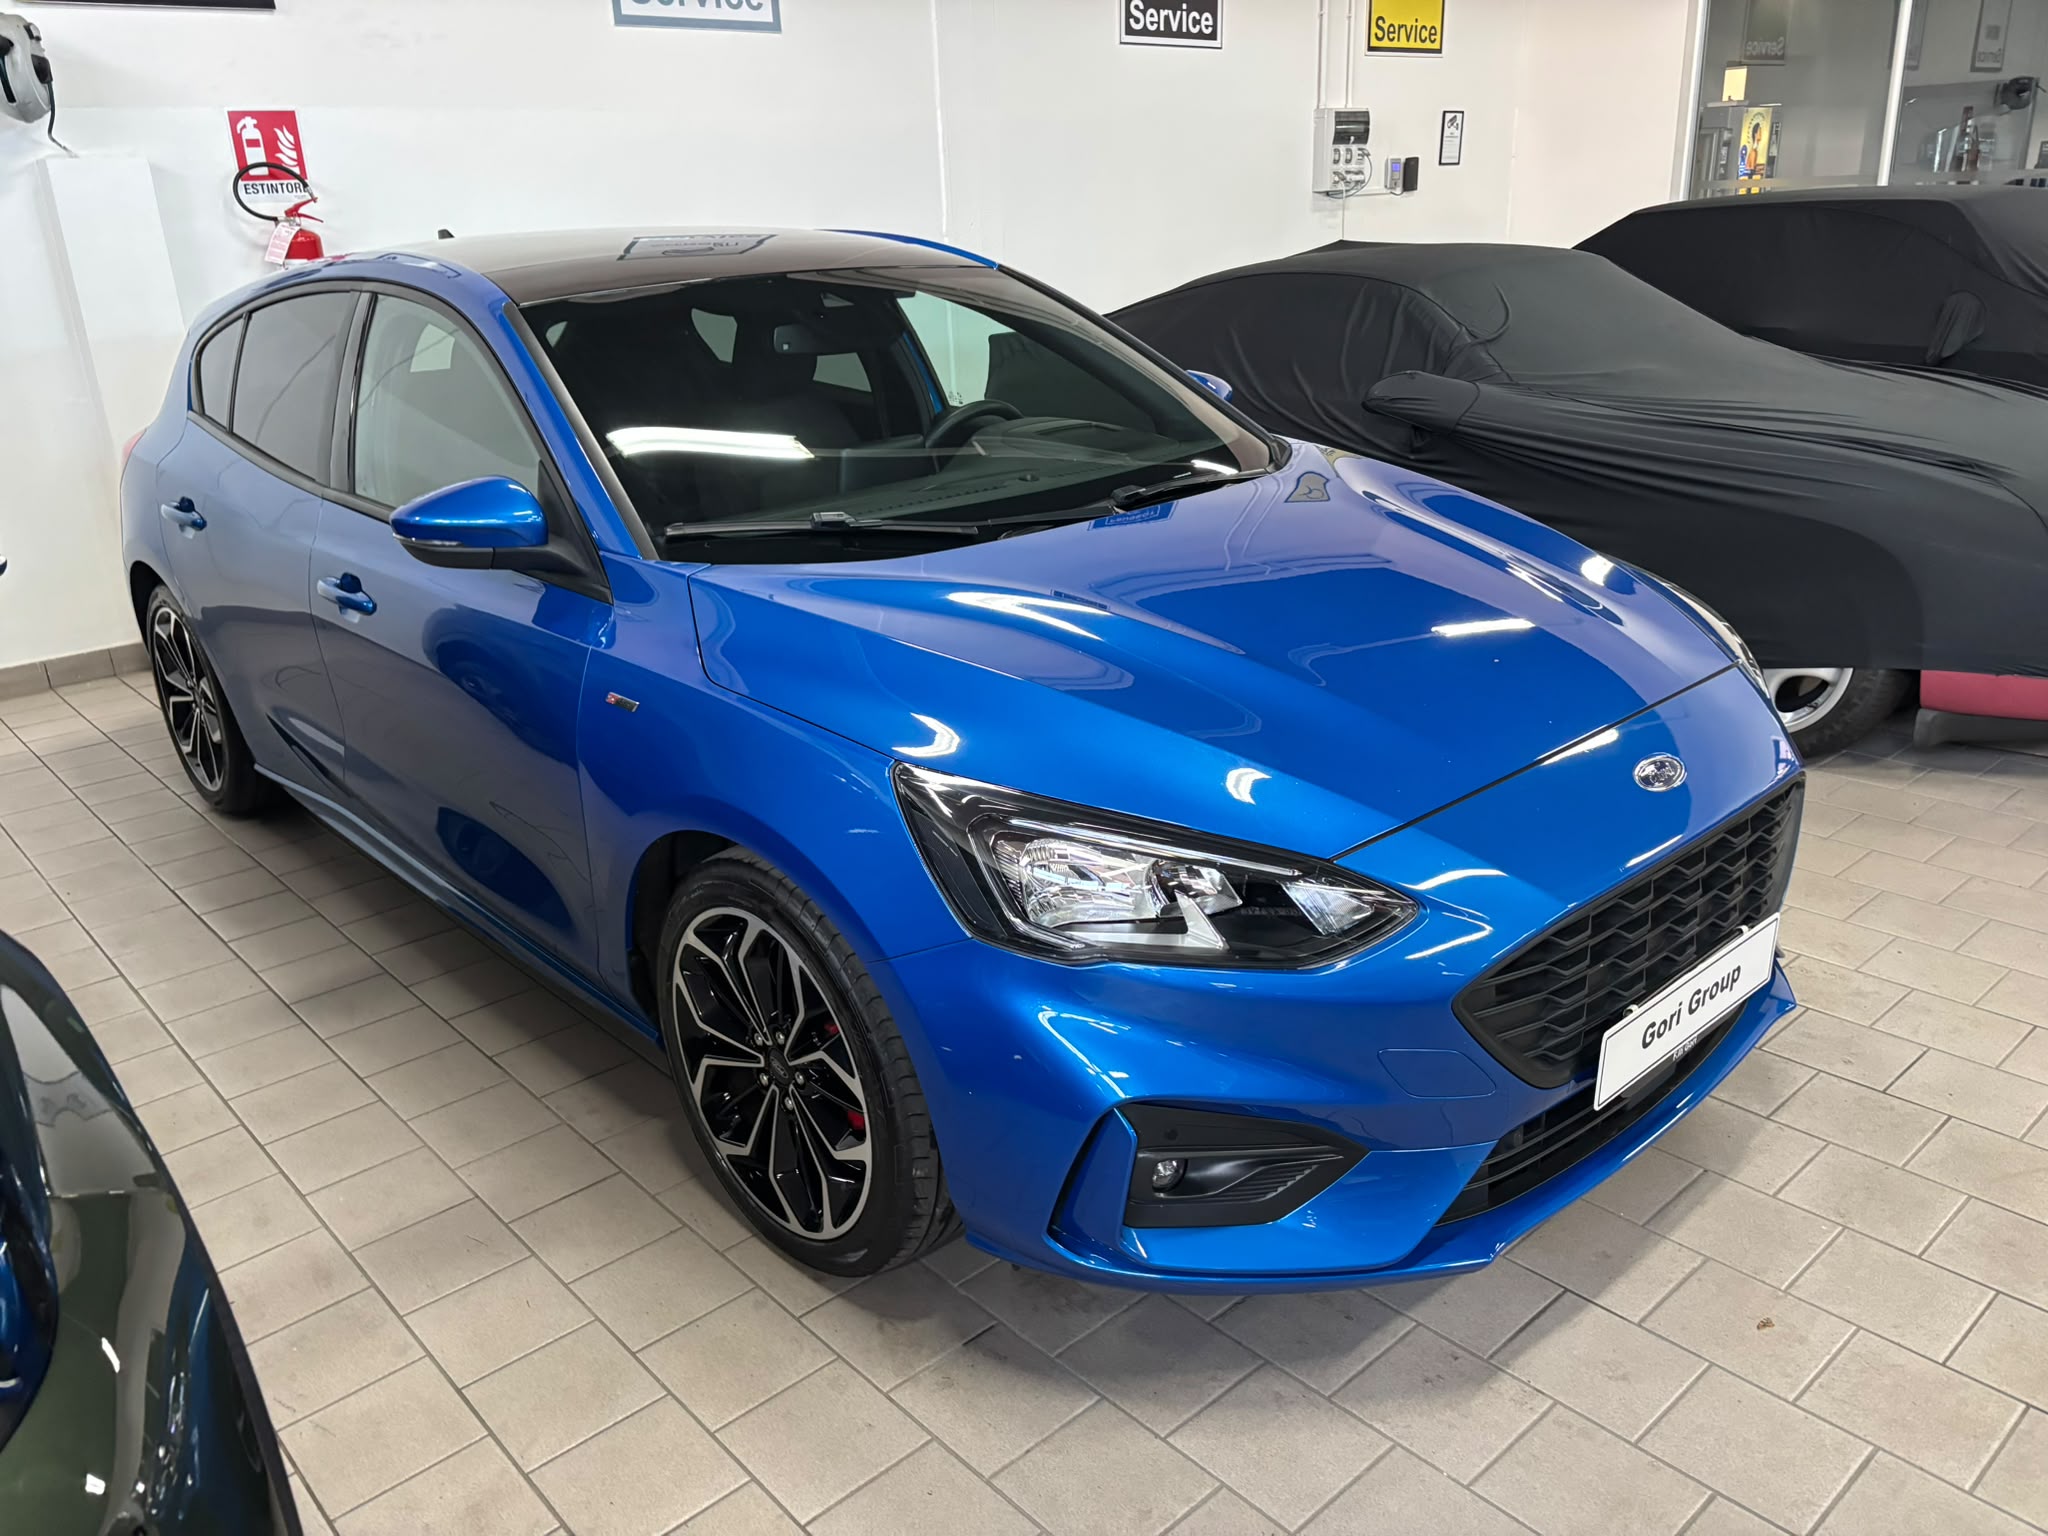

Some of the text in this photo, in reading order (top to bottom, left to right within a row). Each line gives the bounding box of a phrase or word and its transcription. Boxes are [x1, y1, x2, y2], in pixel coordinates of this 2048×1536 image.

[1129, 0, 1214, 35] Service
[1374, 15, 1438, 44] Service
[1642, 1001, 1683, 1049] Gori
[1688, 965, 1742, 1015] Group
